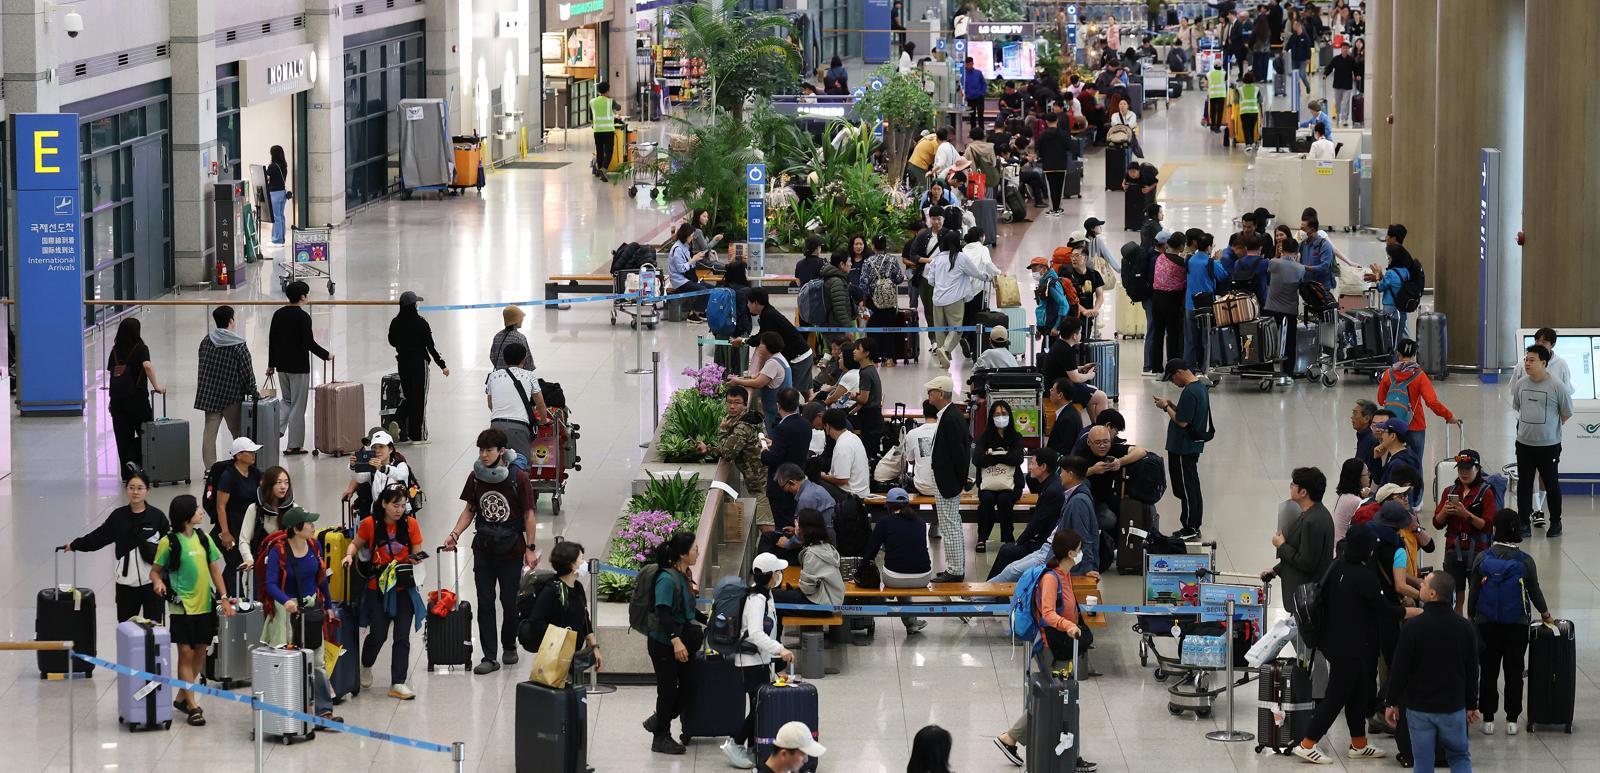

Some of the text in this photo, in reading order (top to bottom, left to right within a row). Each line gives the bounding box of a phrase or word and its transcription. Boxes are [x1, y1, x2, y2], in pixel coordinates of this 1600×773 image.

[978, 26, 989, 34] LG
[34, 130, 60, 173] E
[31, 223, 74, 233] 국제선도착
[28, 257, 76, 265] International
